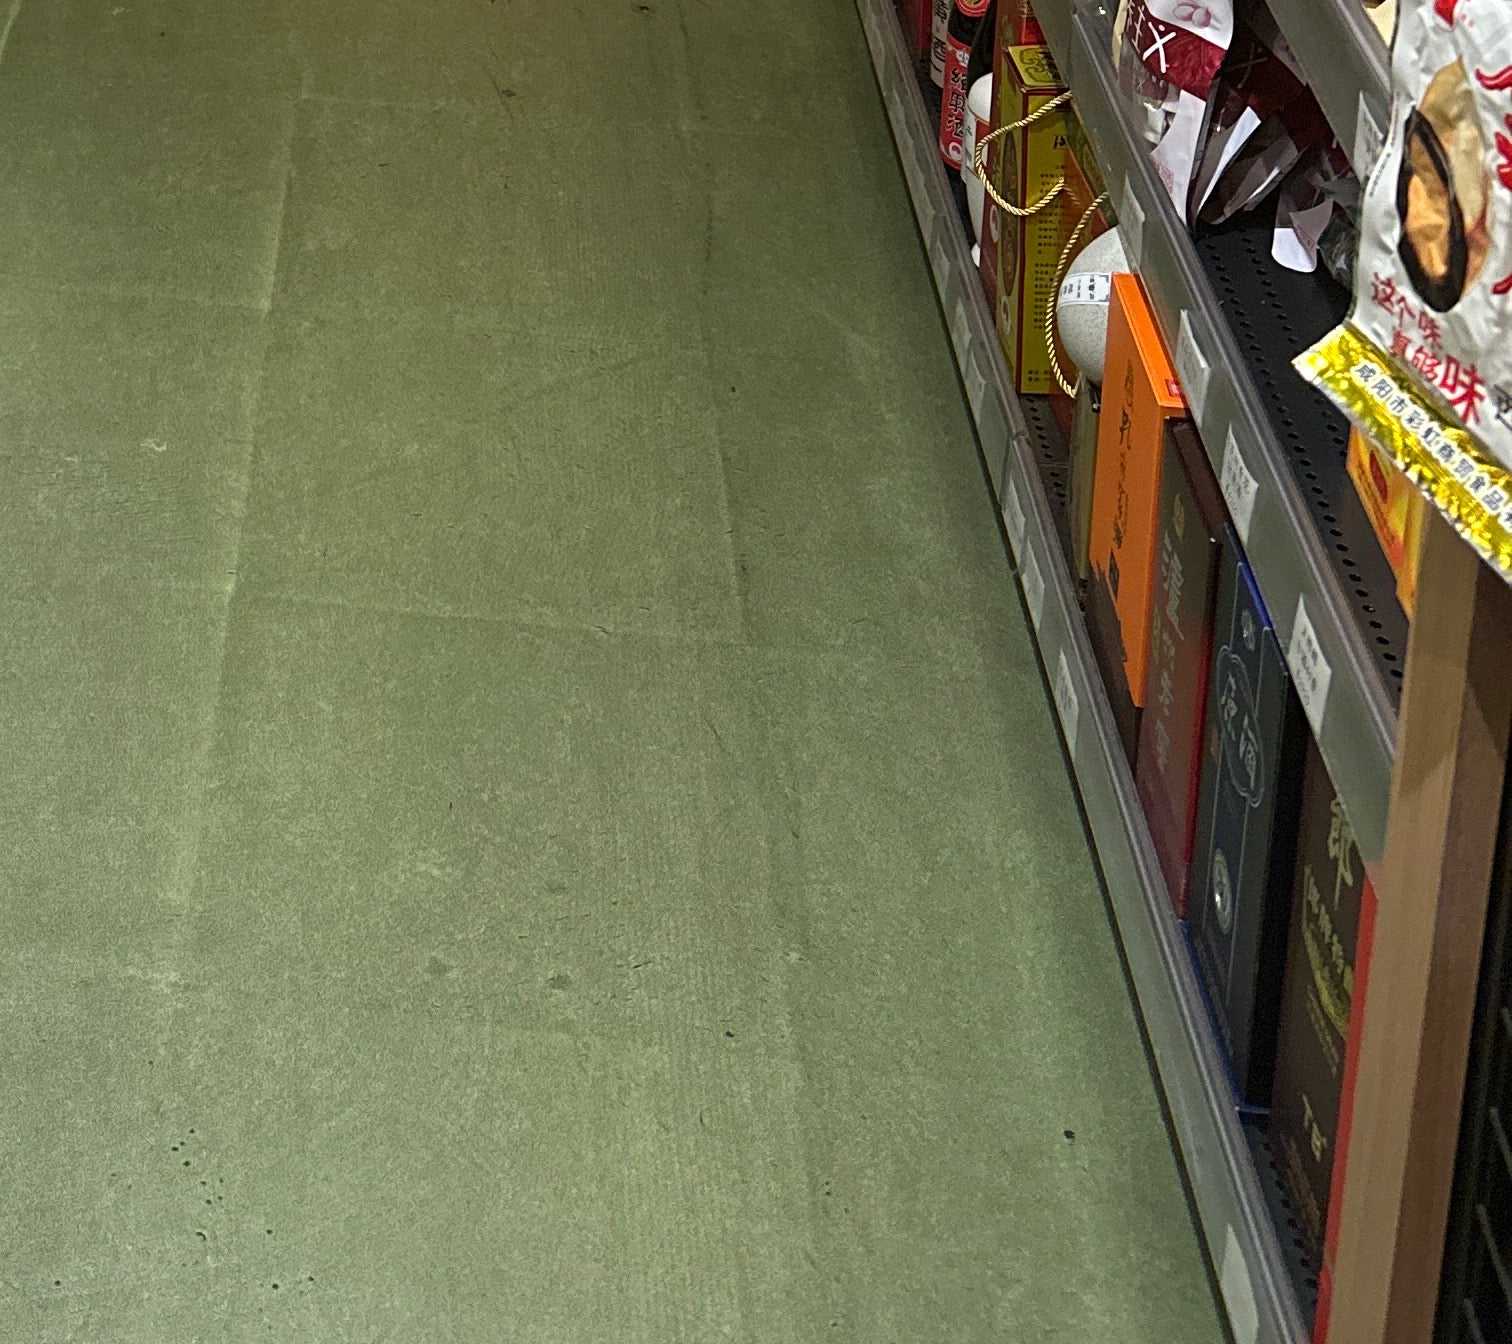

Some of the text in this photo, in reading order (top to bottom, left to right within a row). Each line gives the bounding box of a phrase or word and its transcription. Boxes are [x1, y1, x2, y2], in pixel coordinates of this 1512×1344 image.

[1369, 268, 1445, 354] 这个味
[1389, 324, 1486, 425] 真够味
